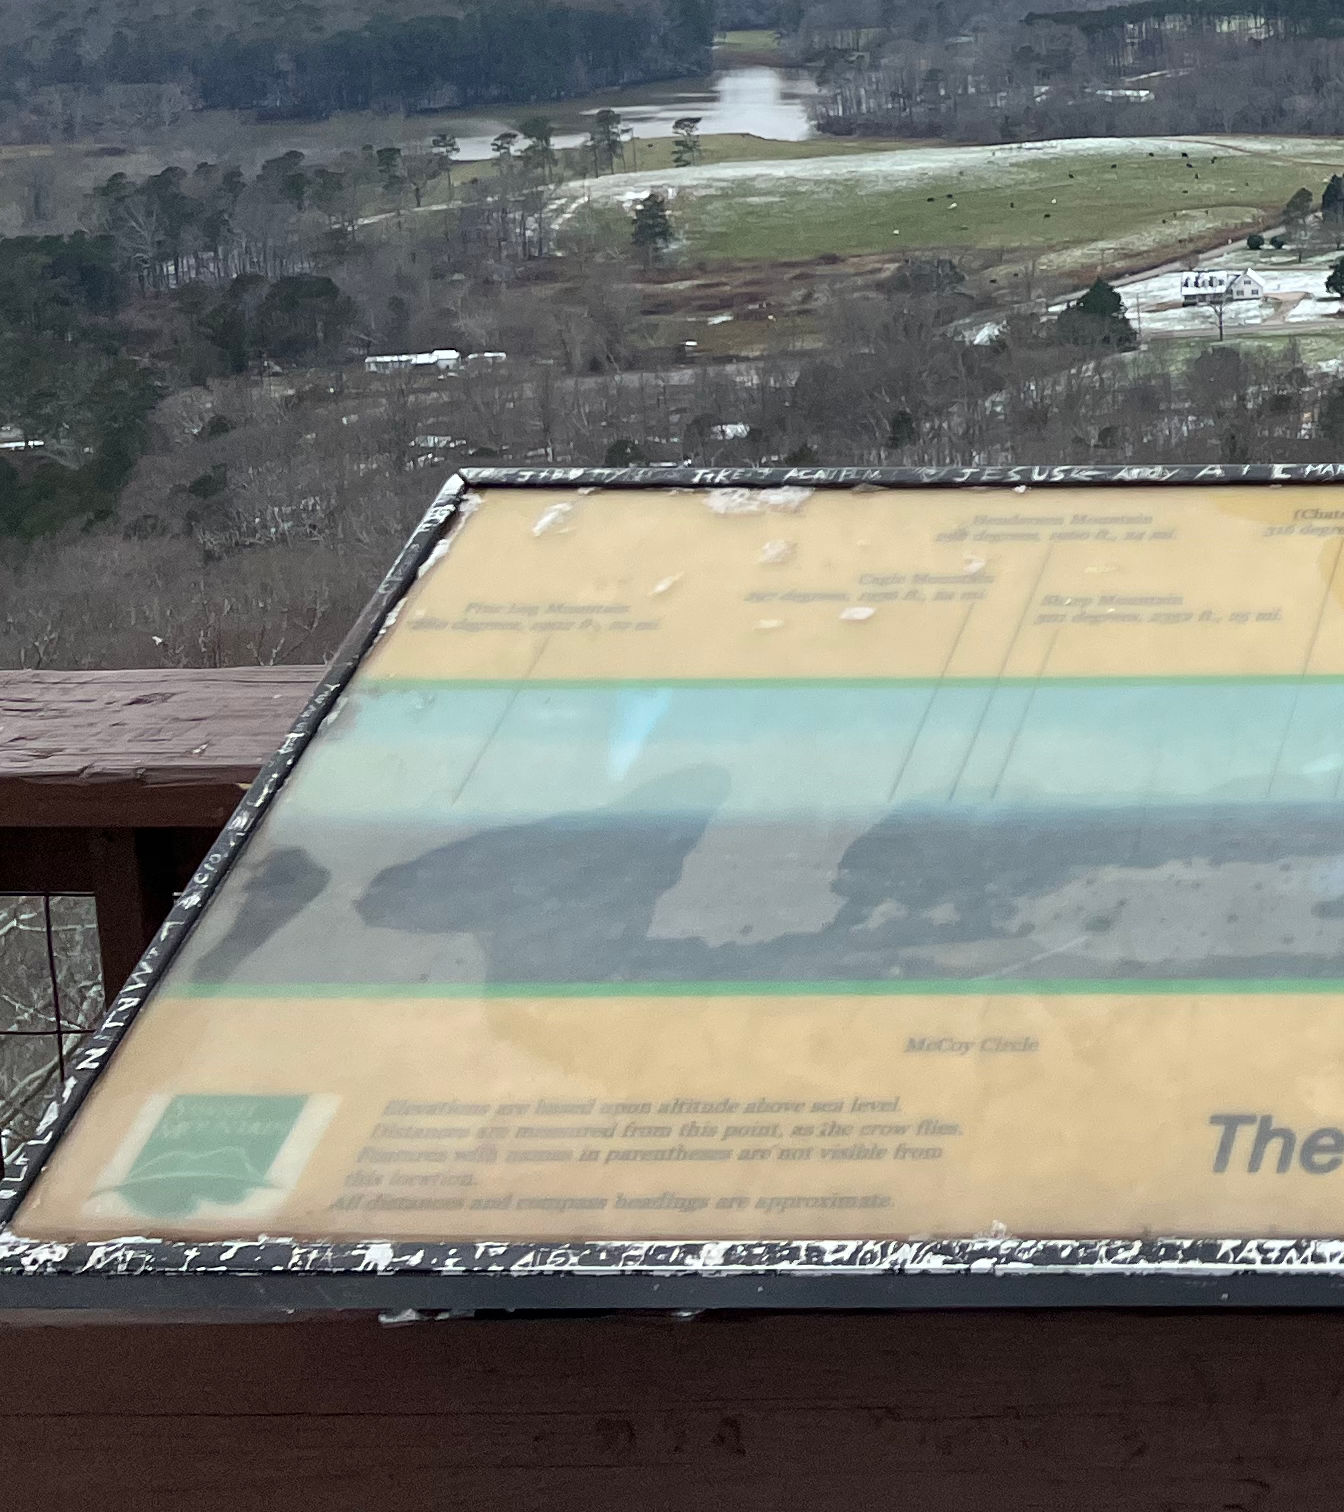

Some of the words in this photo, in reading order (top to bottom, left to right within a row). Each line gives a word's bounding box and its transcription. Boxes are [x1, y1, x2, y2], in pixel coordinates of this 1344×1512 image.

[904, 1037, 975, 1056] McCoy
[979, 1037, 1040, 1053] Circle
[743, 1097, 805, 1115] above
[678, 1120, 718, 1138] this
[858, 1124, 911, 1137] crow
[777, 1144, 812, 1160] not
[893, 1143, 943, 1160] from
